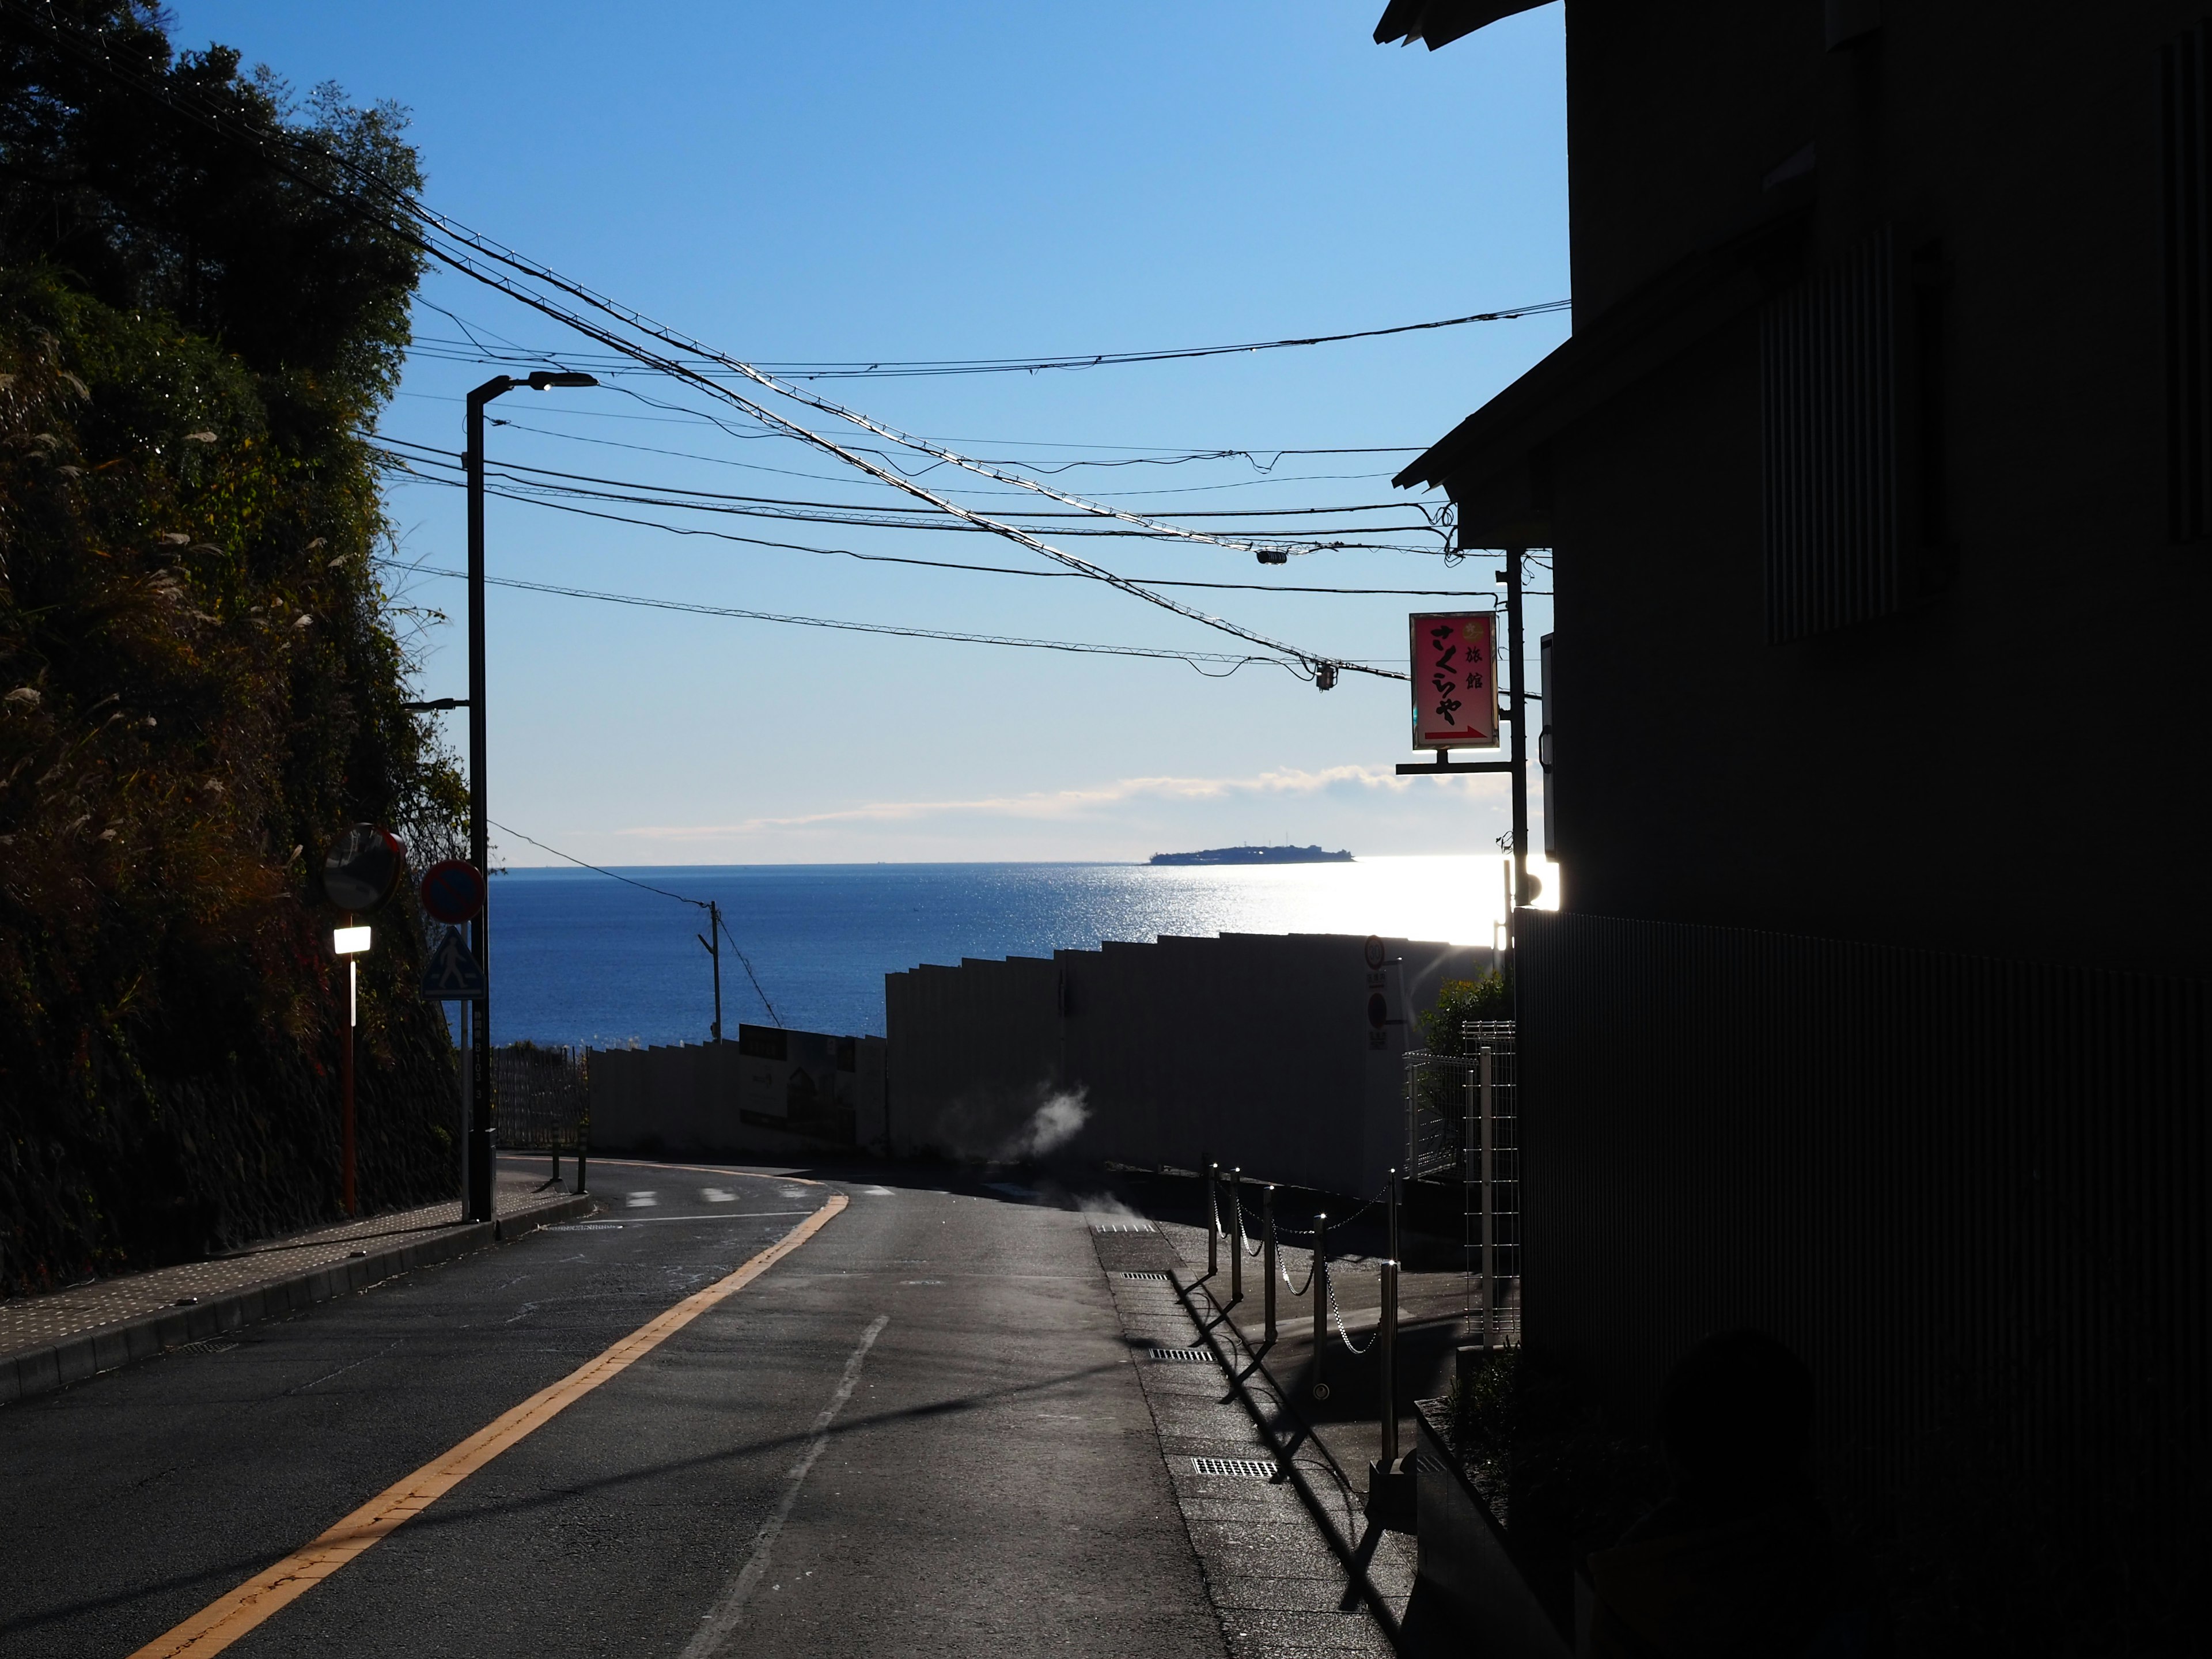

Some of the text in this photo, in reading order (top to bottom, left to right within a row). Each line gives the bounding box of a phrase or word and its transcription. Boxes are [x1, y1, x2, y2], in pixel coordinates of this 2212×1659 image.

[1431, 626, 1461, 725] さくらや
[1465, 646, 1483, 690] 旅館
